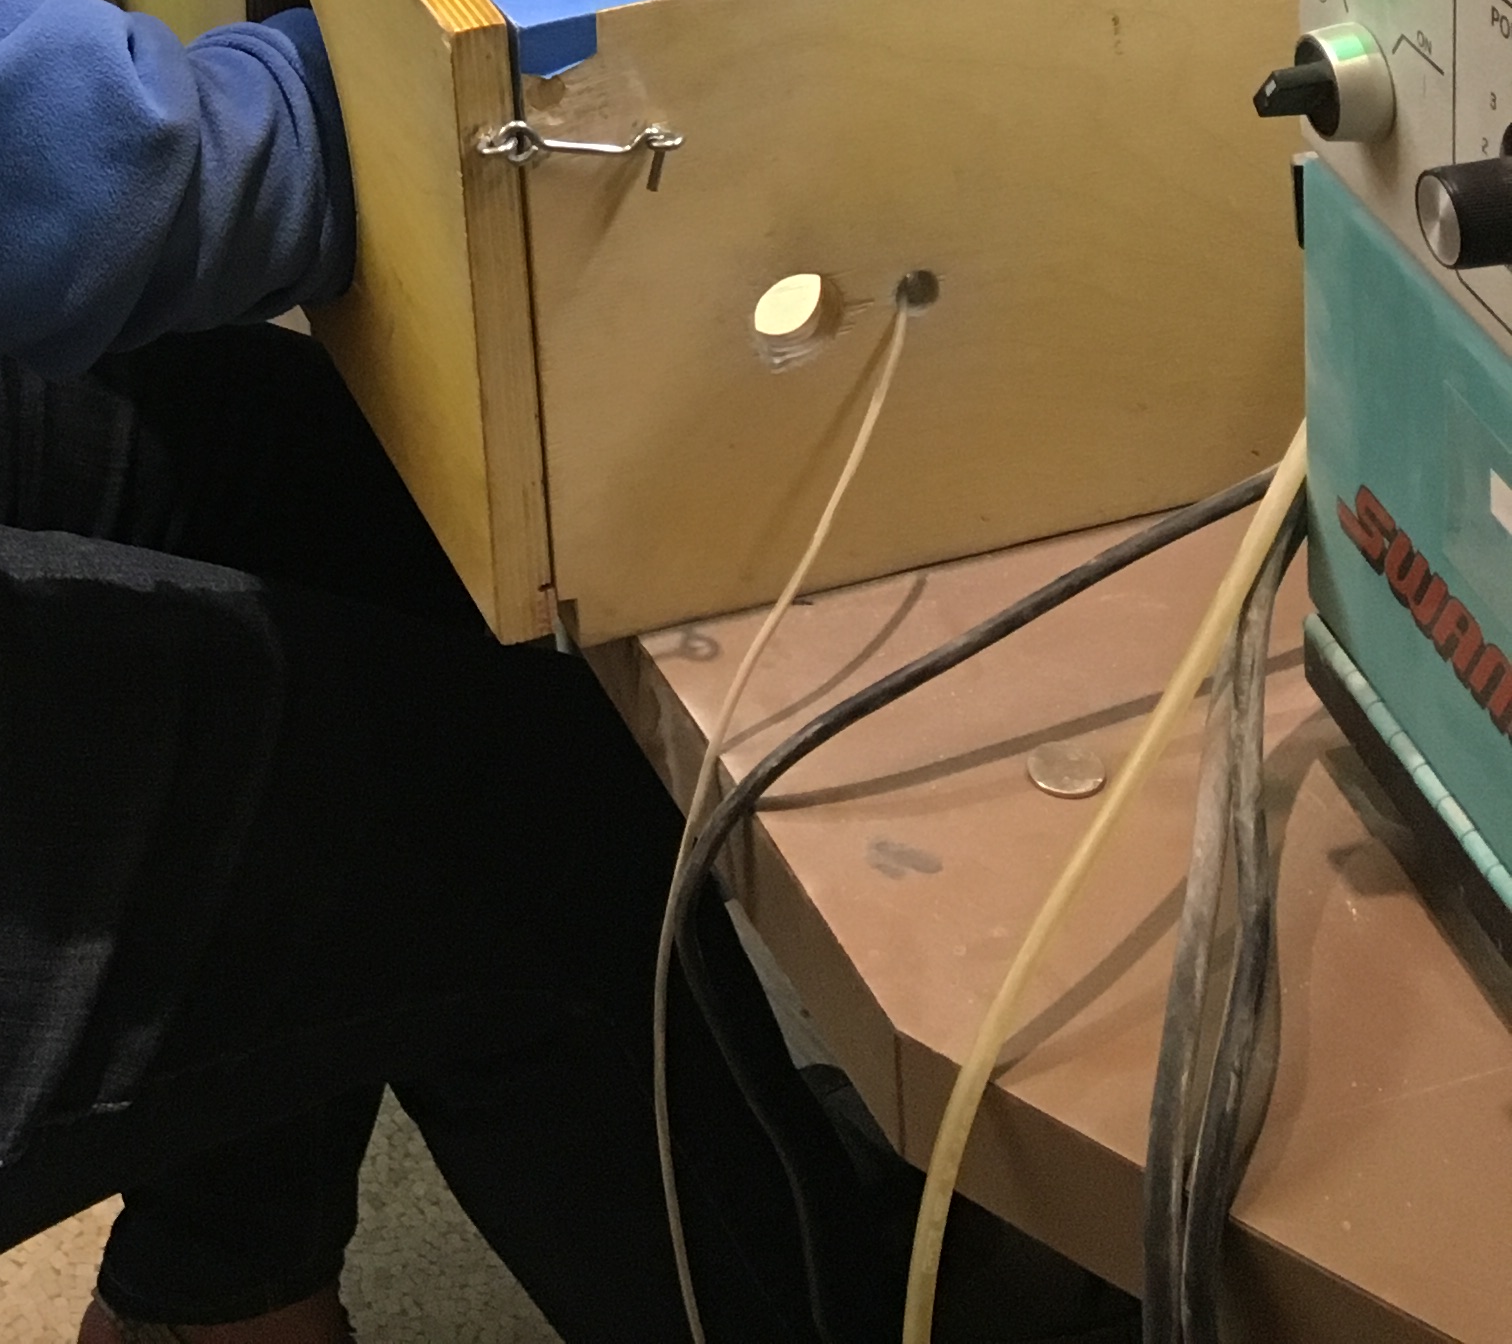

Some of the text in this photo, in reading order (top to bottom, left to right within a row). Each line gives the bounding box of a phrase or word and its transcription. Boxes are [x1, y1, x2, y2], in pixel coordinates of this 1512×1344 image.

[1416, 29, 1433, 55] ON
[1490, 92, 1498, 110] 3
[1482, 137, 1489, 155] 2
